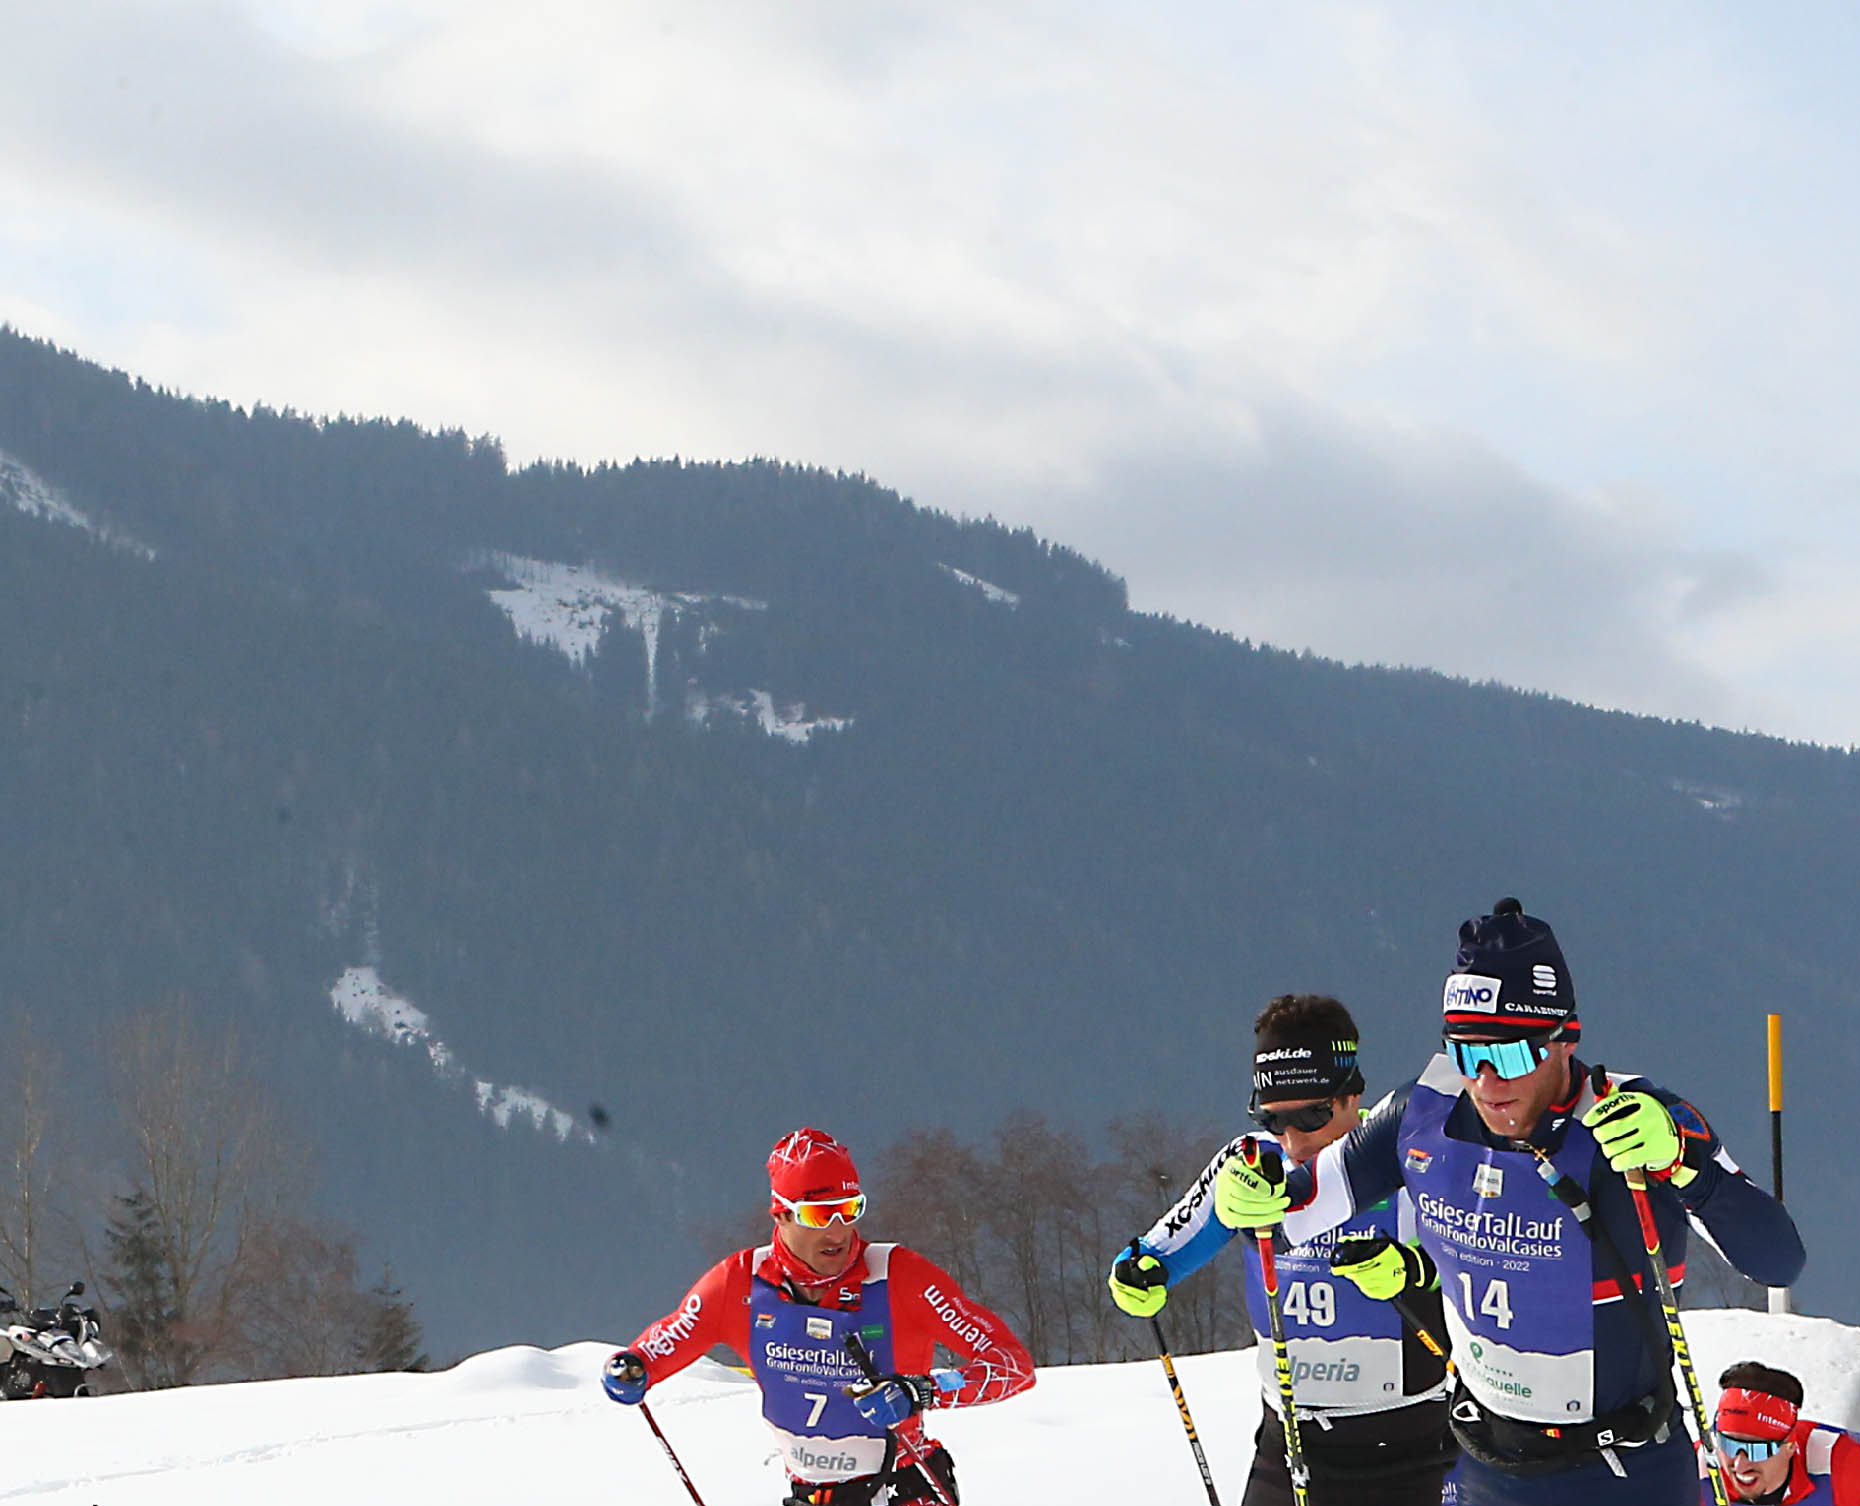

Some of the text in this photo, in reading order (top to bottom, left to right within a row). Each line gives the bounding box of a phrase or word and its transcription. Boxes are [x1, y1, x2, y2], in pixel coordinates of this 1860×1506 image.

[1418, 1193, 1564, 1241] GsieserTalLauf
[1420, 1211, 1563, 1259] GranFondoValCasies
[1459, 1253, 1494, 1268] edition
[1503, 1258, 1531, 1272] 2022
[1283, 1280, 1336, 1327] 49
[1456, 1271, 1515, 1330] 14
[636, 1292, 703, 1363] TRENTINO
[765, 1341, 876, 1368] GsieserTalLaf
[1287, 1356, 1360, 1386] lperia
[803, 1392, 828, 1428] 7
